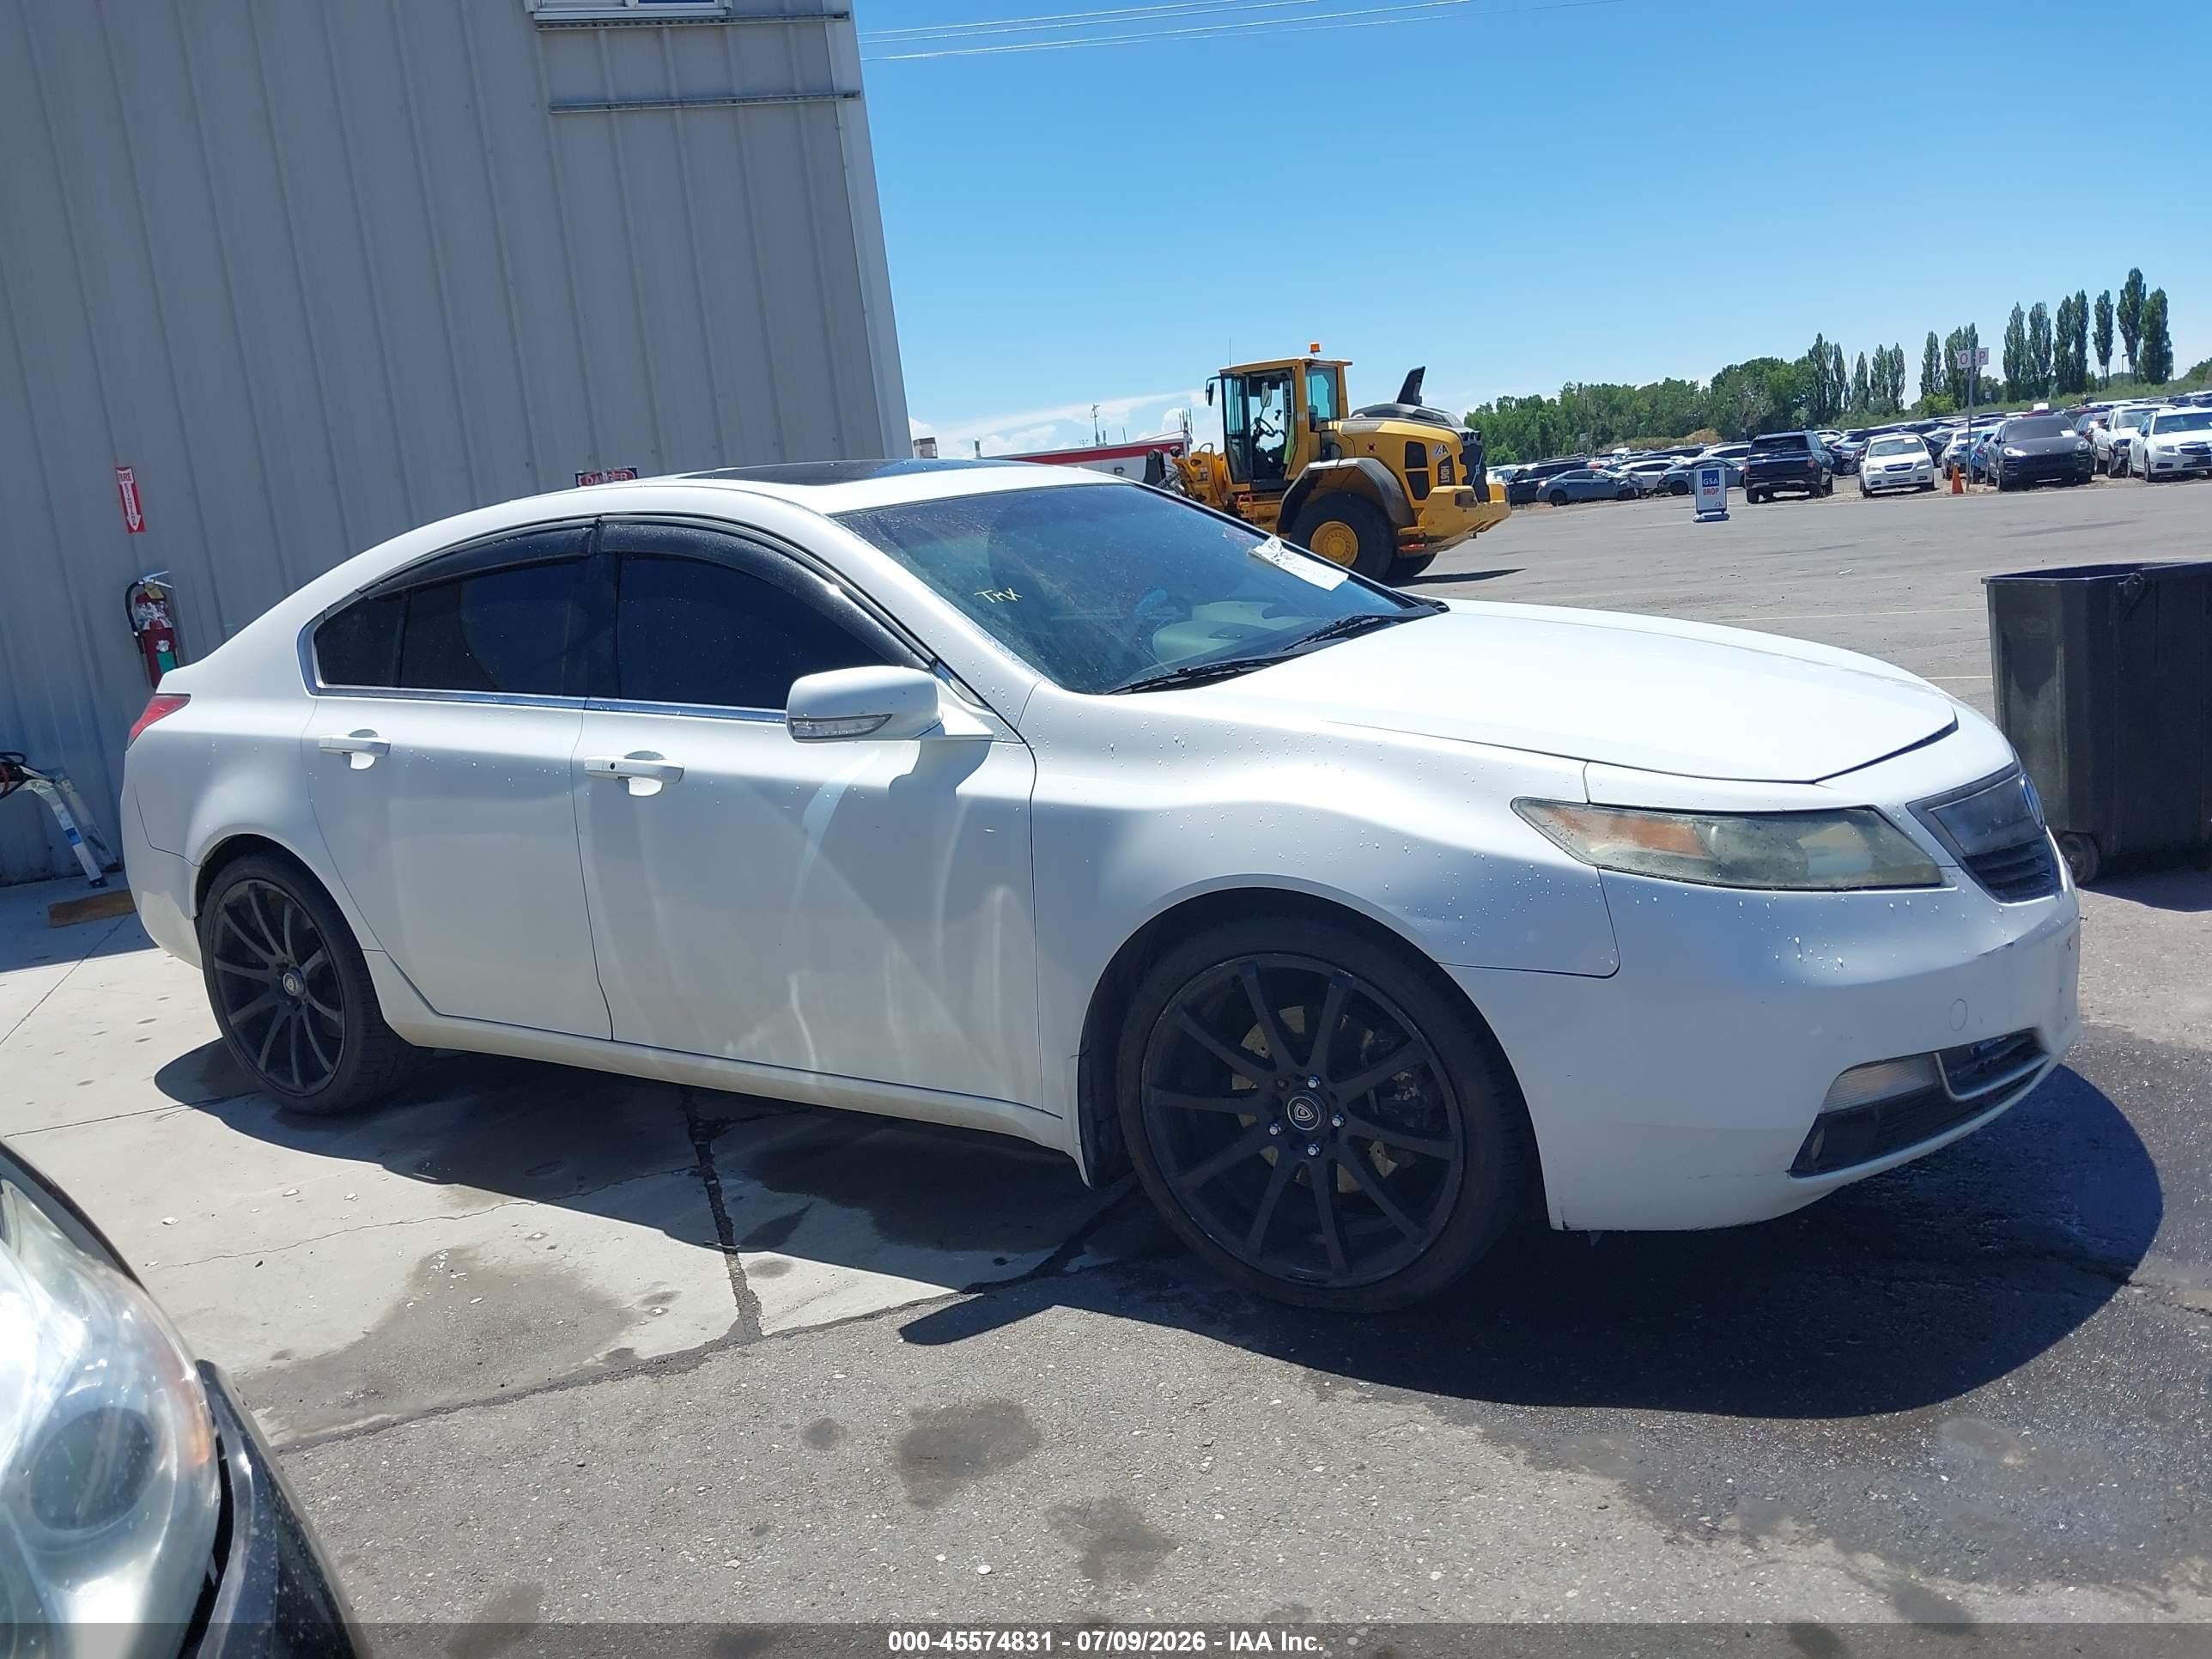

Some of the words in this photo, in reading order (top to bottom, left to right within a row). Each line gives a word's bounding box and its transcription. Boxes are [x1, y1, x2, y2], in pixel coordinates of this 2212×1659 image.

[1978, 350, 1986, 363] P
[585, 471, 629, 485] DANGER
[1703, 477, 1719, 486] GSA
[1703, 487, 1719, 495] DROP
